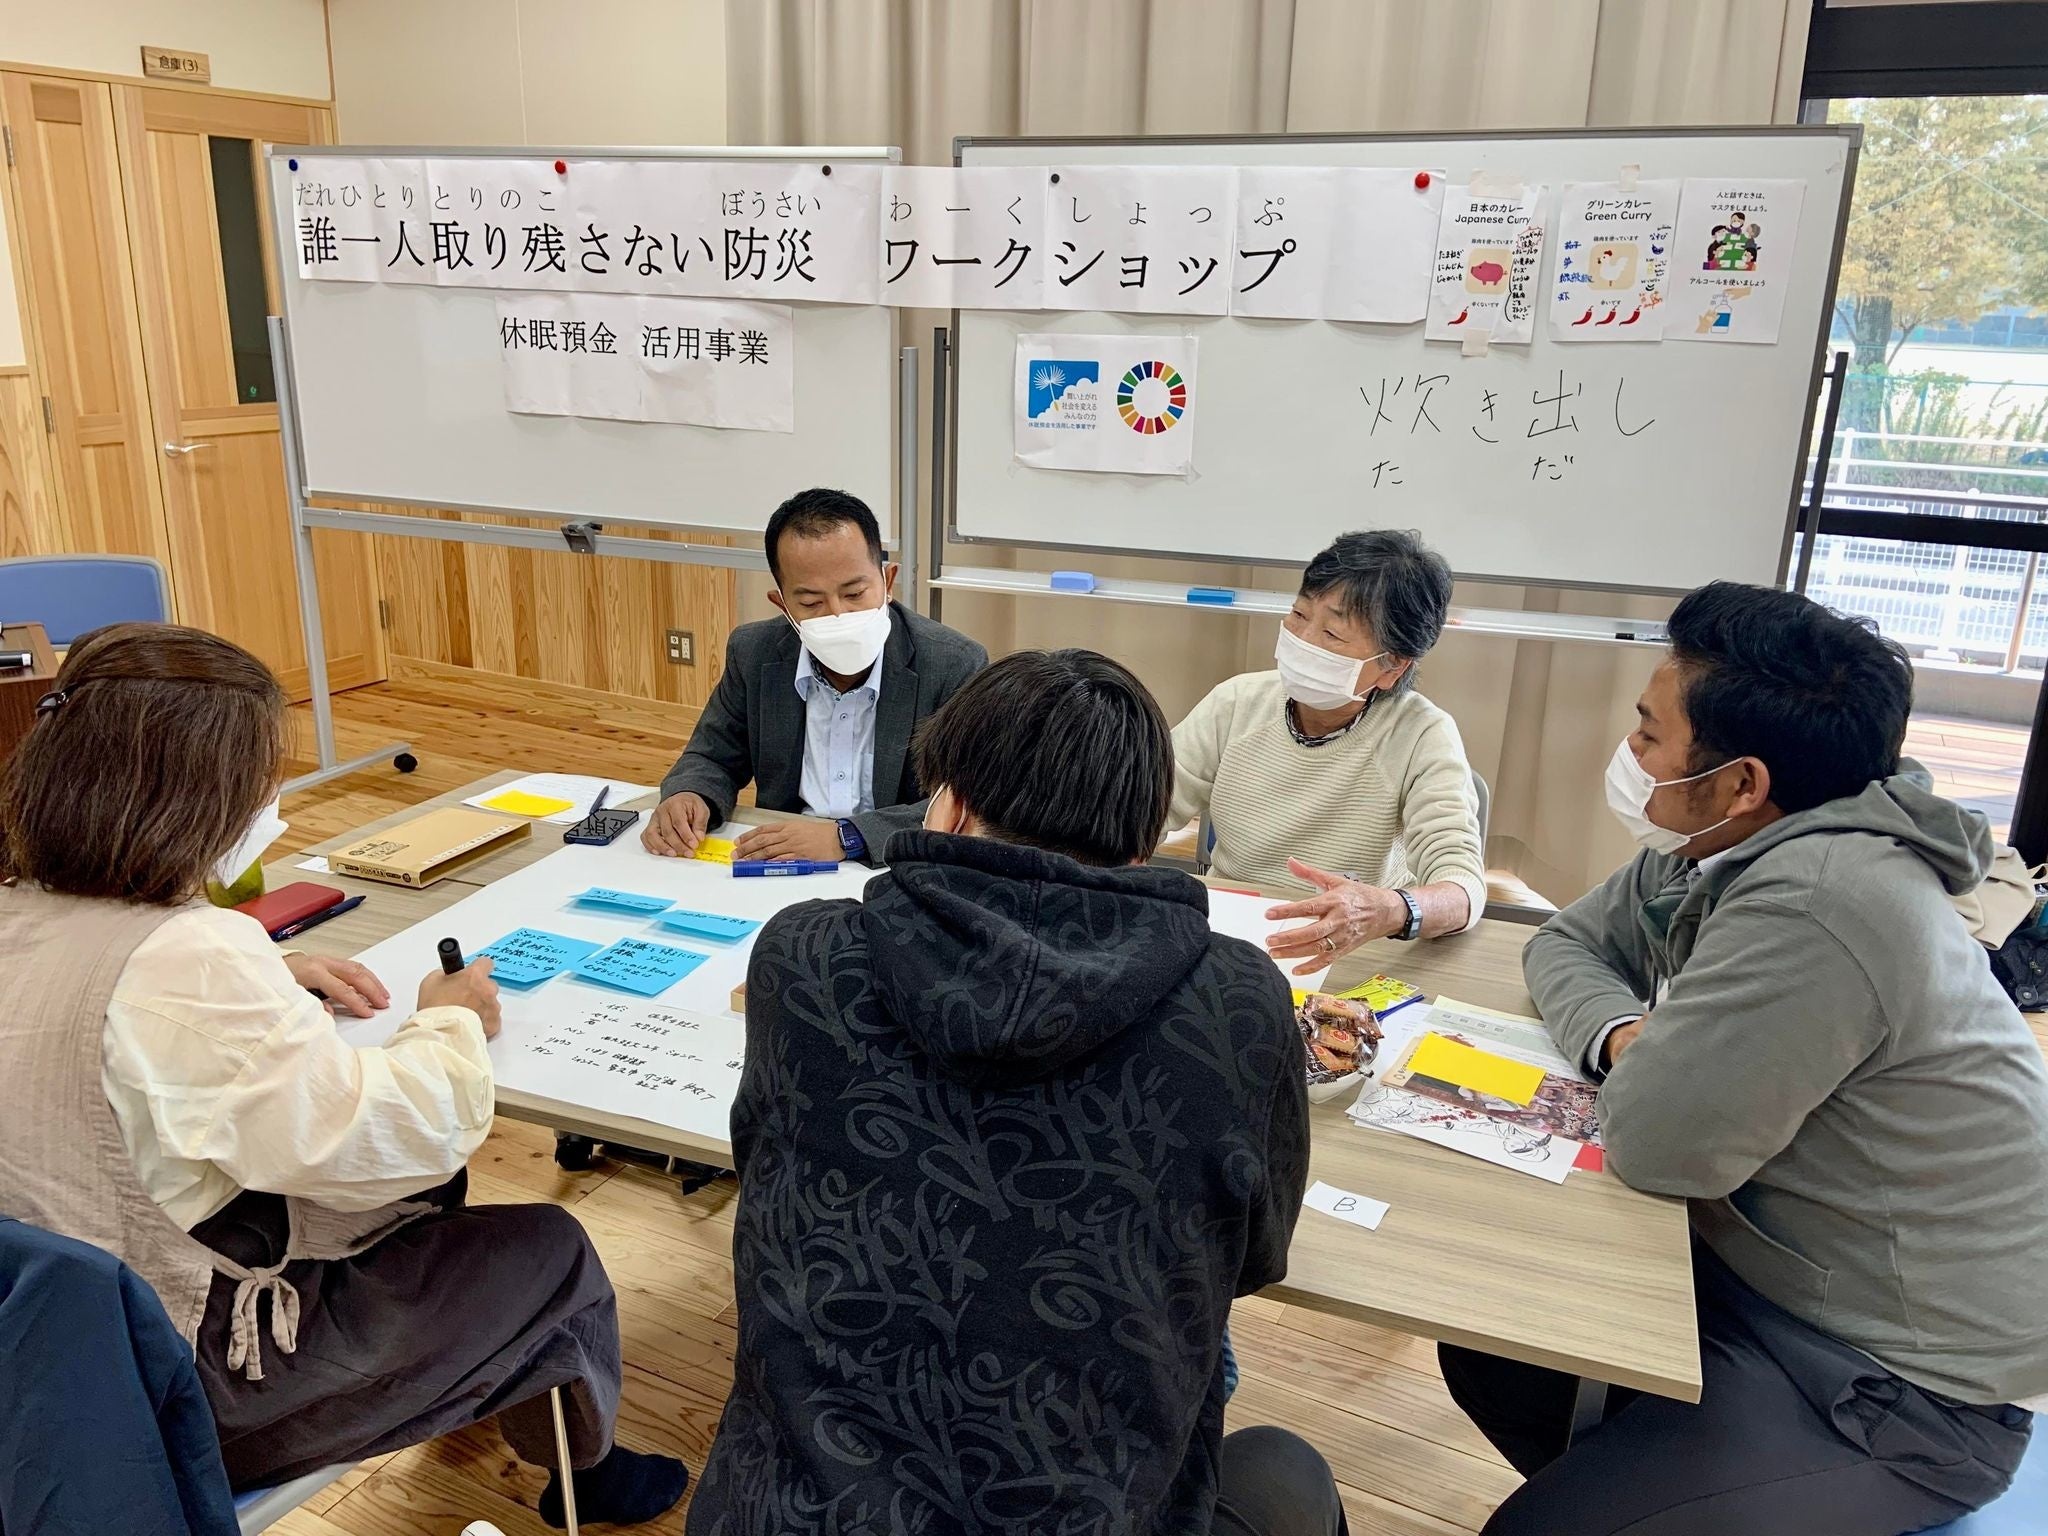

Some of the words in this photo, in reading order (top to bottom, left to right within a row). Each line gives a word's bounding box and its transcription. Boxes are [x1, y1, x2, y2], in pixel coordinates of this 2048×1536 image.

[722, 190, 821, 217] ぼうさい
[890, 194, 1286, 226] わーくしょっぷ
[1470, 203, 1524, 213] 日本のカレー
[1587, 199, 1652, 210] グリーンカレー
[1455, 214, 1504, 225] Japanese
[1507, 215, 1532, 226] Curry
[1585, 211, 1617, 221] Green
[1620, 210, 1652, 222] Curry
[299, 216, 817, 283] 誰一人取り残さない防災
[885, 238, 1297, 296] ワークショップ
[500, 317, 618, 355] 休眠預金
[642, 325, 769, 365] 活用事業
[1360, 369, 1656, 443] 炊き出し
[1333, 1196, 1356, 1211] B
